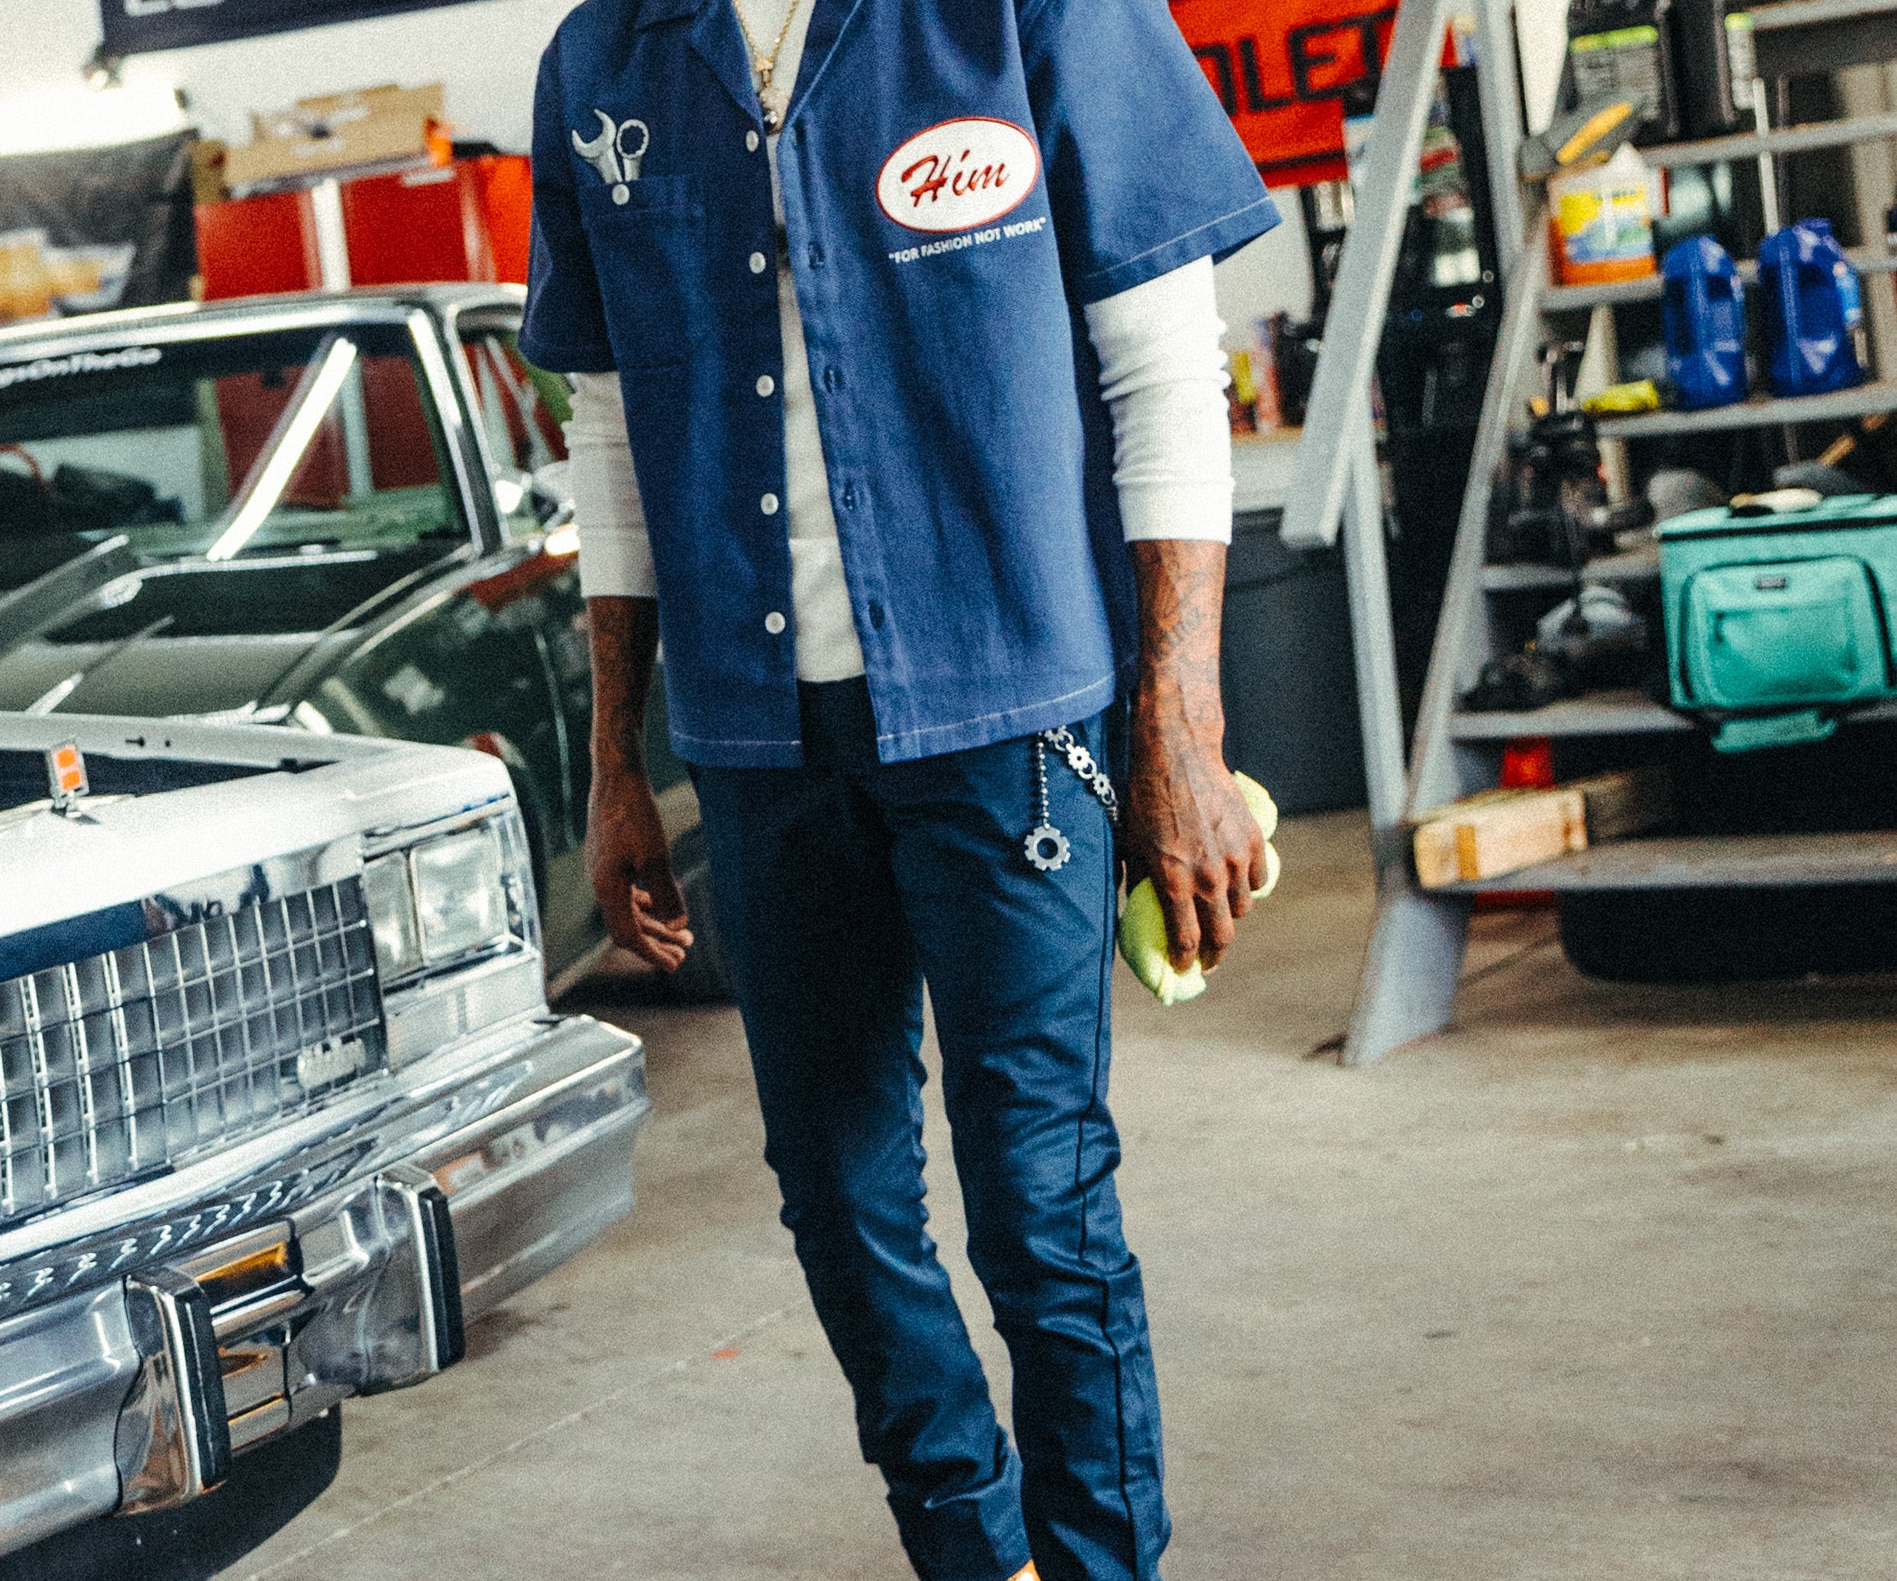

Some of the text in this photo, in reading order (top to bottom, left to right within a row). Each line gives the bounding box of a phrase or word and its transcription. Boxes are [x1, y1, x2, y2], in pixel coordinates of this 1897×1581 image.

[900, 149, 1011, 208] Him
[921, 234, 973, 257] FASHION
[974, 228, 1001, 245] NOT
